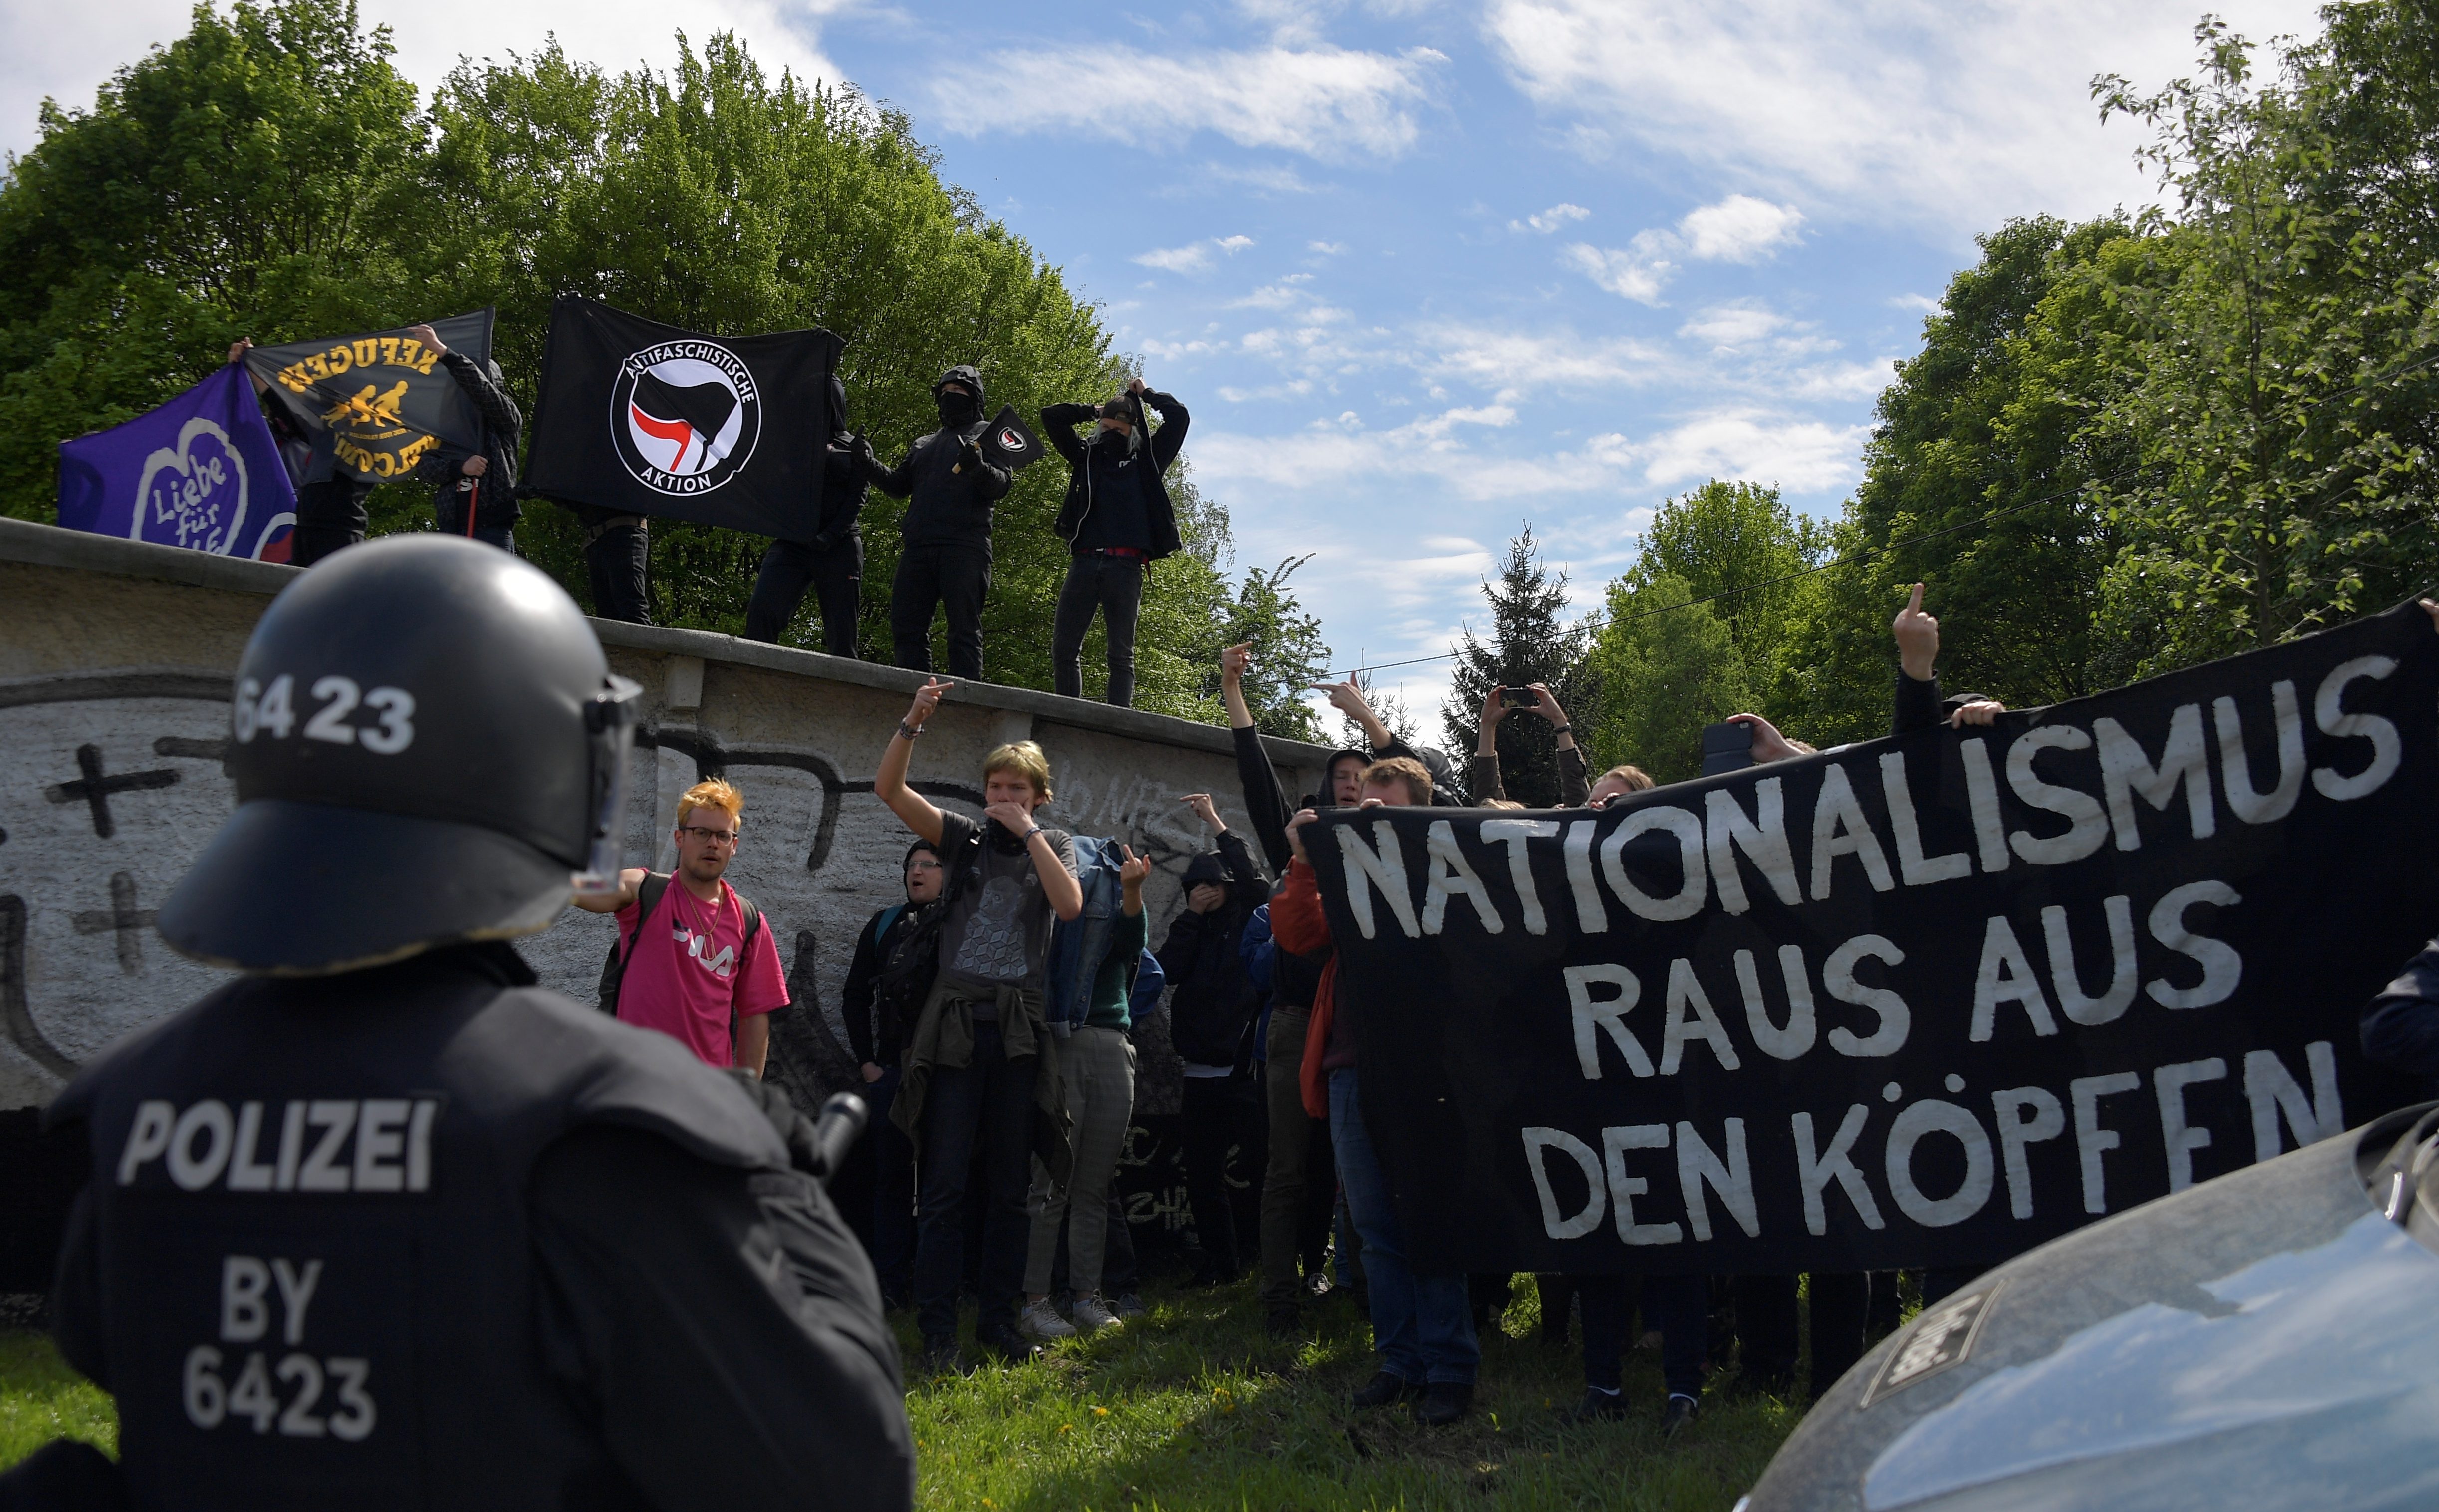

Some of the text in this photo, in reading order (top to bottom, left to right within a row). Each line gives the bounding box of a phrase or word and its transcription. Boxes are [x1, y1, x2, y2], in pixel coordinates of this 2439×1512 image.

[625, 344, 754, 404] ANTIFASCHISTISCHE
[153, 454, 227, 524] Liebe
[176, 503, 220, 547] für
[641, 466, 711, 492] AKTION
[234, 673, 416, 755] 6423
[1333, 655, 2402, 939] NATIONALISMUS
[1563, 880, 2242, 1080] RAUS AUS
[116, 1099, 438, 1192] POLIZEI
[1522, 1041, 2345, 1246] DEN KÖPFEN
[219, 1254, 325, 1347] BY
[181, 1345, 378, 1443] 6423
